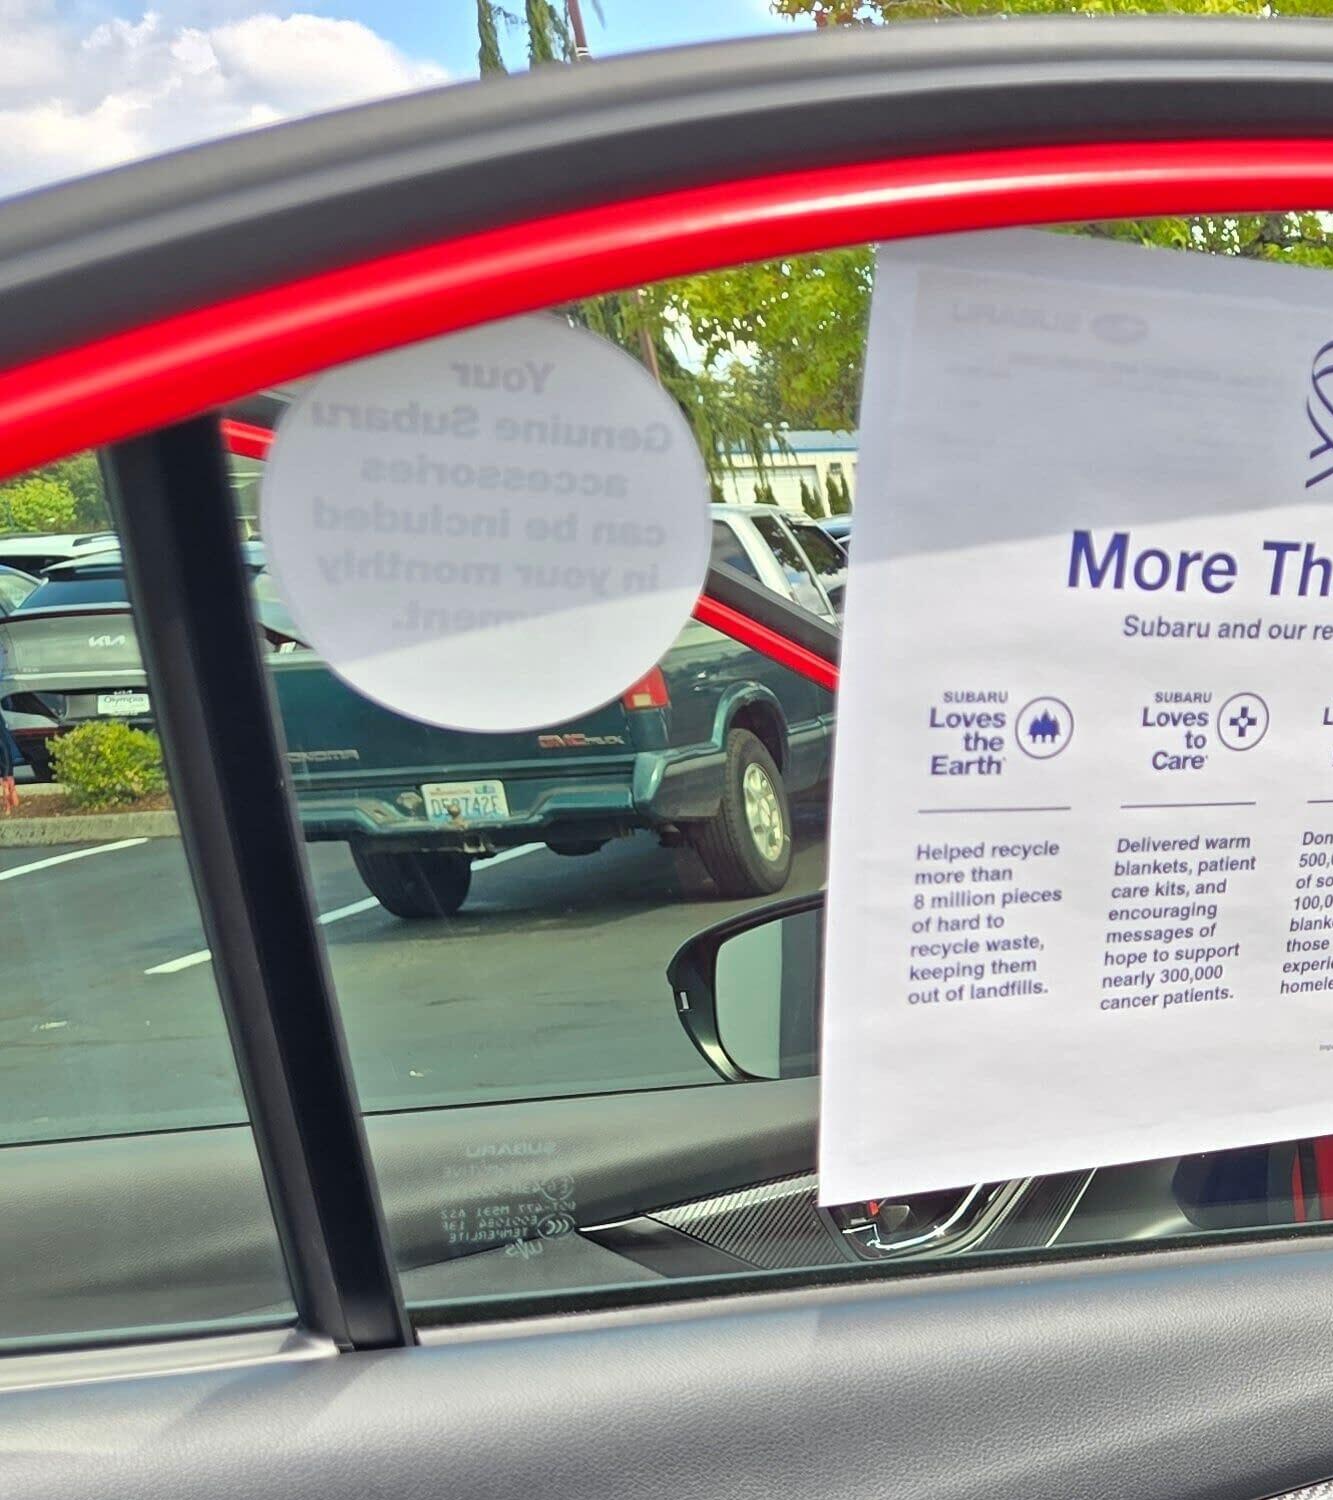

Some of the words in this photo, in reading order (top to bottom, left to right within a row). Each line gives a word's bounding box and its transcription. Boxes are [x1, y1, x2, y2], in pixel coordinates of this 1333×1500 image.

[1068, 530, 1238, 594] More
[1123, 614, 1211, 639] Subaru
[1217, 618, 1262, 640] and
[1268, 623, 1308, 640] our
[943, 691, 1009, 704] SUBARU
[1154, 691, 1212, 704] SUBARU
[929, 707, 1006, 729] Loves
[1142, 707, 1209, 727] Loves
[963, 731, 1005, 753] the
[1184, 730, 1207, 750] to
[930, 755, 1002, 776] Earth
[1151, 750, 1208, 771] Care
[916, 842, 985, 864] Helped
[991, 840, 1060, 861] recycle
[1117, 834, 1201, 853] Delivered
[1205, 837, 1251, 850] warm
[914, 871, 965, 885] more
[971, 866, 1013, 882] than
[1113, 859, 1193, 877] blankets,
[1197, 856, 1257, 877] patient
[1111, 886, 1150, 899] care
[1155, 880, 1190, 897] kits,
[1195, 878, 1227, 895] and
[1295, 874, 1313, 890] of
[913, 894, 925, 911] 8
[931, 890, 996, 909] million
[1001, 887, 1062, 909] pieces
[1108, 902, 1218, 921] encouraging
[911, 917, 932, 934] of
[937, 913, 981, 932] hard
[986, 914, 1005, 929] to
[1106, 927, 1194, 944] messages
[1199, 922, 1217, 938] of
[910, 938, 980, 959] recycle
[986, 934, 1045, 952] waste,
[1104, 951, 1148, 968] hope
[1153, 948, 1170, 962] to
[1174, 942, 1240, 963] support
[1286, 938, 1330, 953] those
[909, 962, 985, 983] keeping
[991, 959, 1037, 975] them
[1102, 970, 1155, 989] nearly
[1160, 964, 1224, 984] 300,000
[907, 988, 940, 1005] out
[945, 985, 964, 1002] of
[970, 979, 1049, 1000] landfills.
[1100, 994, 1159, 1011] cancer
[1163, 986, 1234, 1009] patients.
